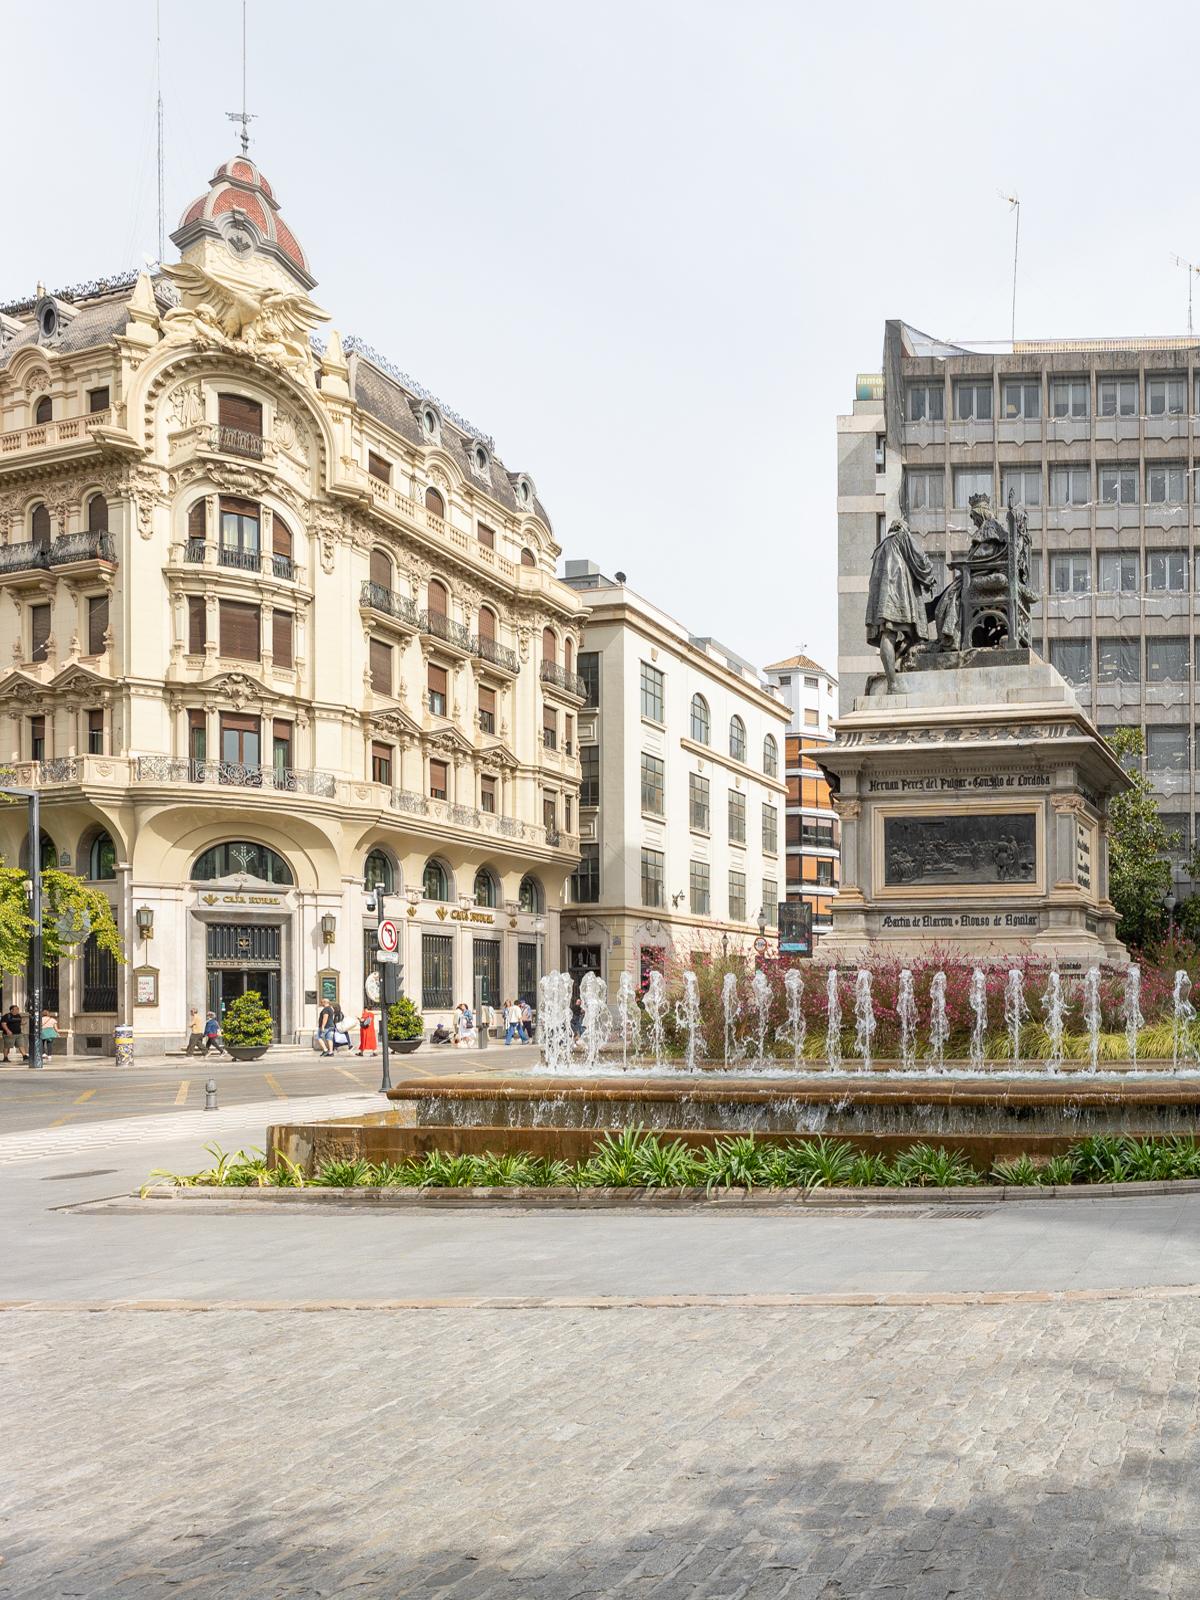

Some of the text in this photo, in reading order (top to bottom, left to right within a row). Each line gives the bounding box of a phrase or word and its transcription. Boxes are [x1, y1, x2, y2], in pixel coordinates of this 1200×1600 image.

[926, 777, 938, 789] del
[1006, 775, 1014, 787] de
[223, 896, 280, 905] CAJA RURAL
[912, 917, 921, 927] de
[993, 915, 1002, 926] de
